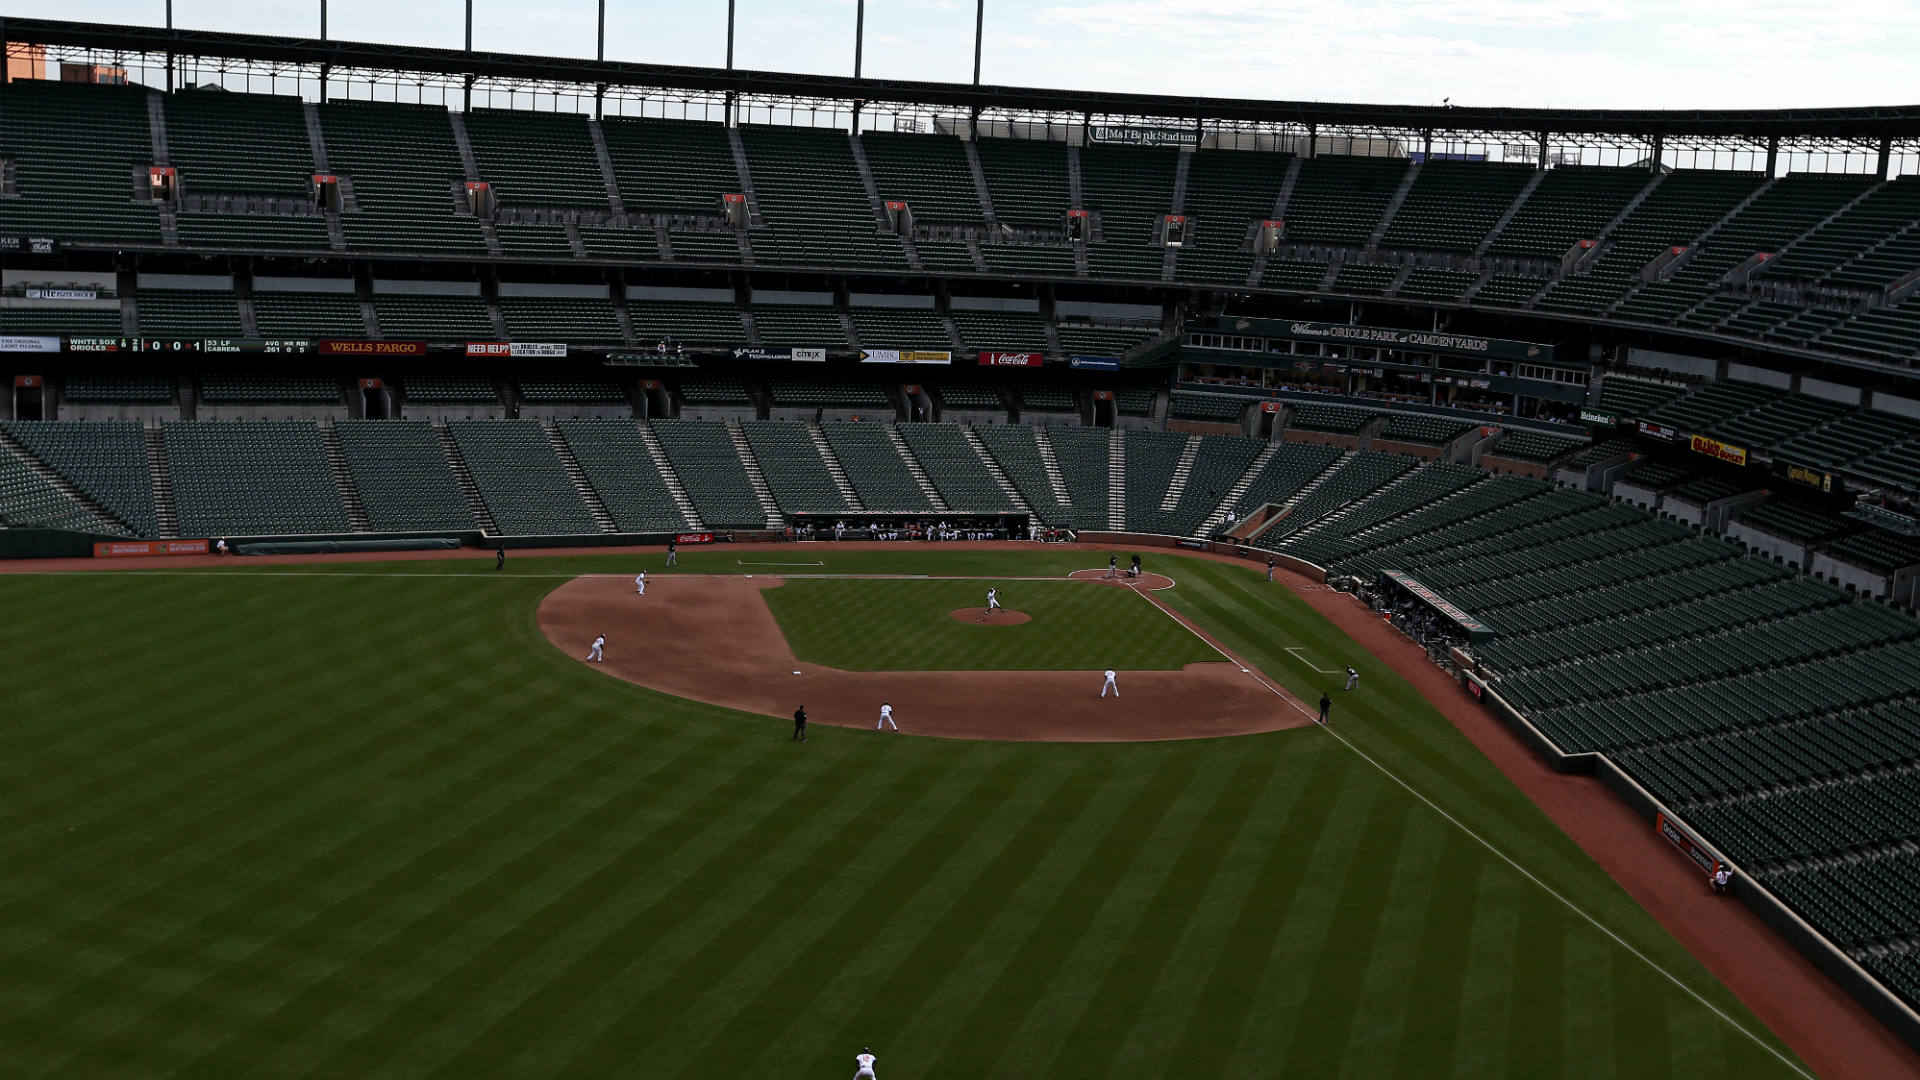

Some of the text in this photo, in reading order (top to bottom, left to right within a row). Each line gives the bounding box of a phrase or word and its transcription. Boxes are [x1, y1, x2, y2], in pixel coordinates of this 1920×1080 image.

[1109, 129, 1130, 138] M&T
[1131, 130, 1156, 140] Bank
[70, 338, 116, 346] WHITE SOX
[1290, 322, 1322, 336] Welcome
[1329, 326, 1370, 340] ORIOLE
[1370, 330, 1398, 343] PARK
[1408, 333, 1455, 347] CAMDEN
[1454, 337, 1488, 352] YARDS
[152, 341, 161, 351] 0
[173, 341, 182, 351] 0
[193, 341, 200, 351] 1
[330, 342, 416, 353] WELLS FARGO
[468, 344, 509, 354] NEED HELP?
[872, 350, 895, 359] UMBC
[998, 353, 1030, 365] Coca-Cola
[1580, 410, 1609, 424] Heineken
